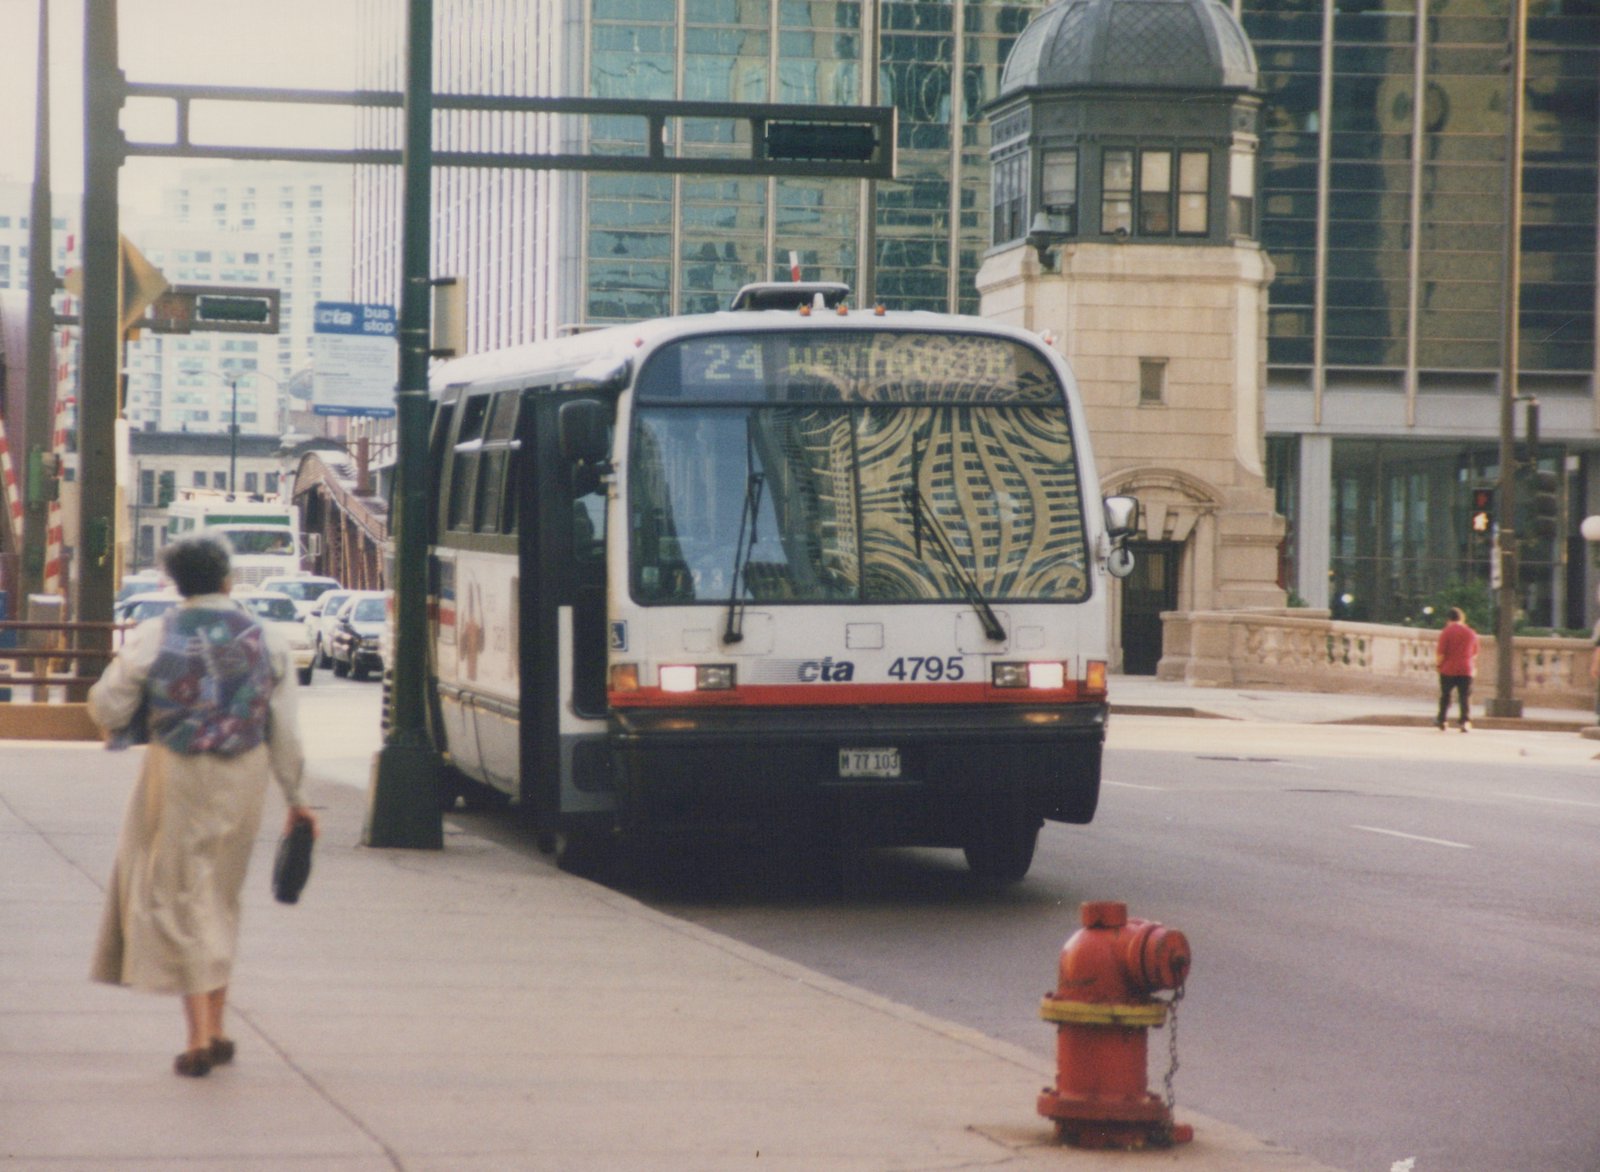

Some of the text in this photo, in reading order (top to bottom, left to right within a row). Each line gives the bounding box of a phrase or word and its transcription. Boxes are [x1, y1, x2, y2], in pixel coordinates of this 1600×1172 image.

[320, 309, 353, 326] cta
[363, 306, 390, 320] bus
[363, 320, 394, 334] stop
[704, 343, 764, 380] 24
[798, 656, 855, 682] cta
[887, 656, 965, 682] 4795
[854, 753, 869, 769] 77
[874, 753, 898, 769] 103
